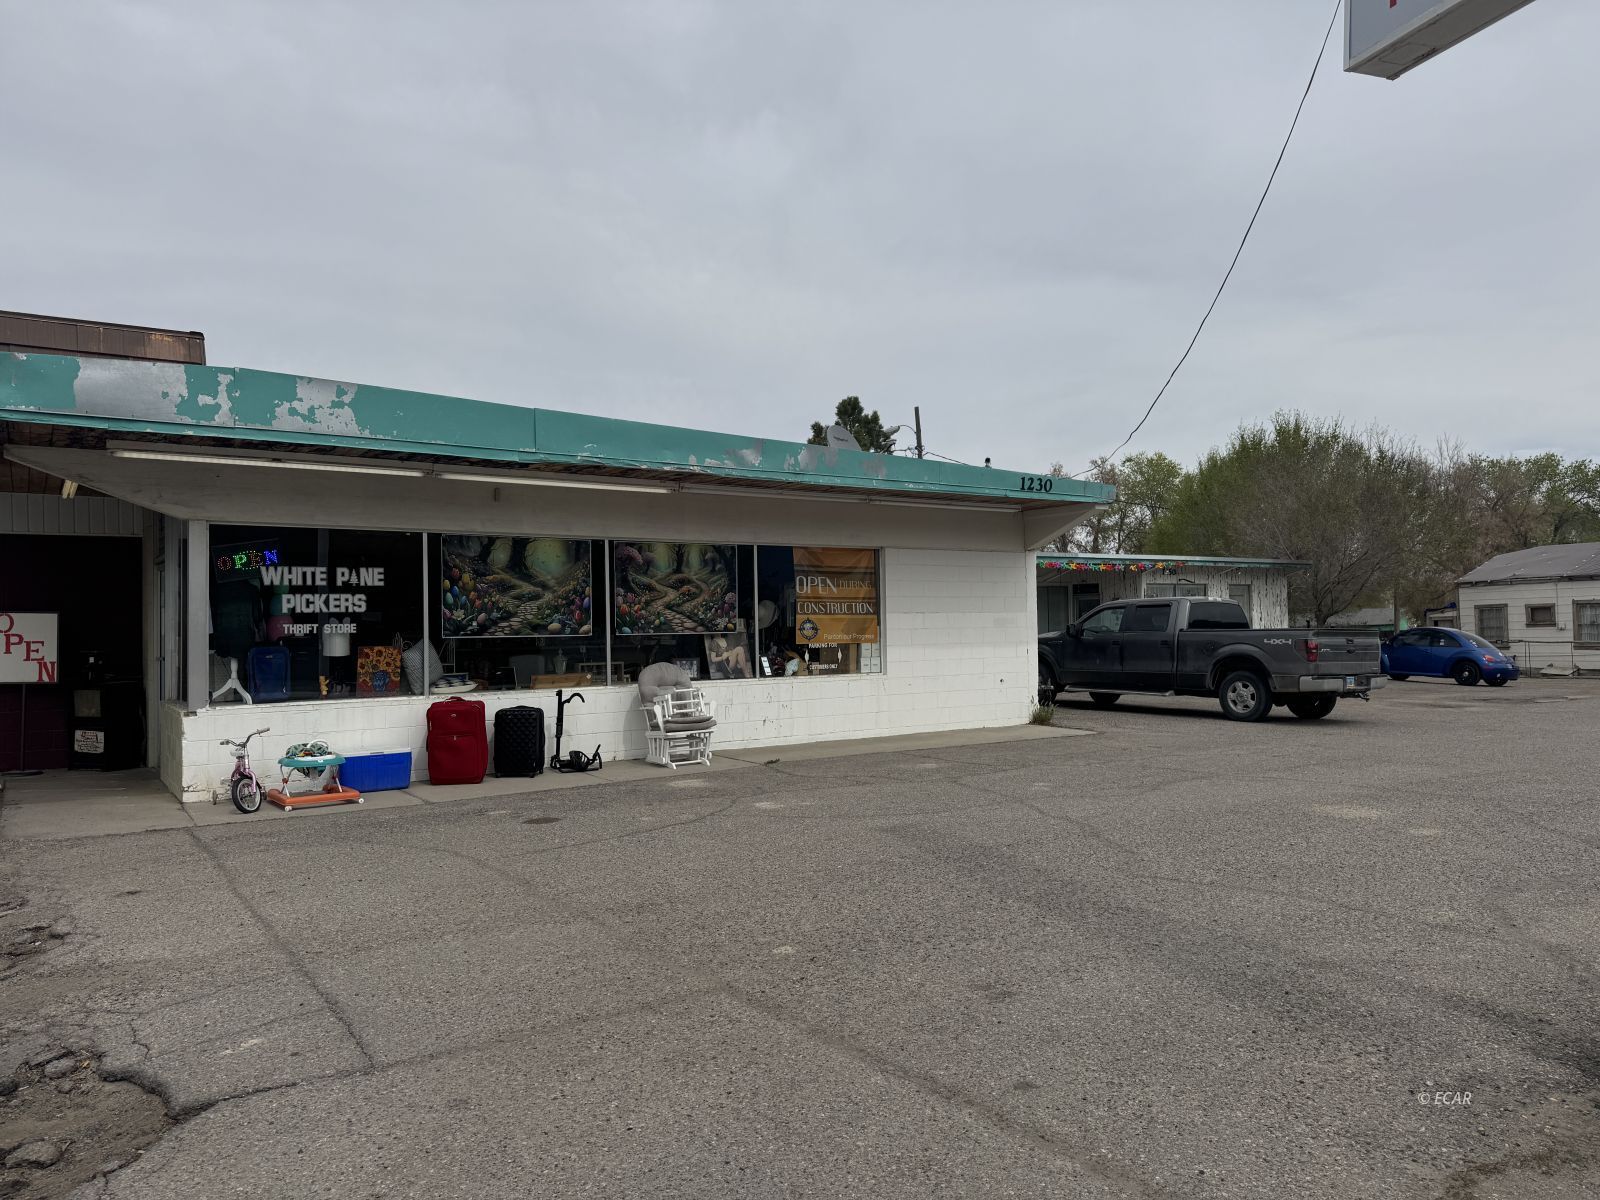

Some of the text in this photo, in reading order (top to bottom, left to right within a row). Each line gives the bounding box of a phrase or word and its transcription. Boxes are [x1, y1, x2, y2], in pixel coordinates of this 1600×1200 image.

[1020, 477, 1053, 492] 1230
[217, 549, 278, 570] OPEN
[260, 566, 328, 586] WHITE
[796, 576, 872, 594] OPEN DURING
[281, 594, 367, 613] PICKERS
[797, 602, 874, 614] CONSTRUCTION
[283, 624, 357, 634] THRIFT STORE
